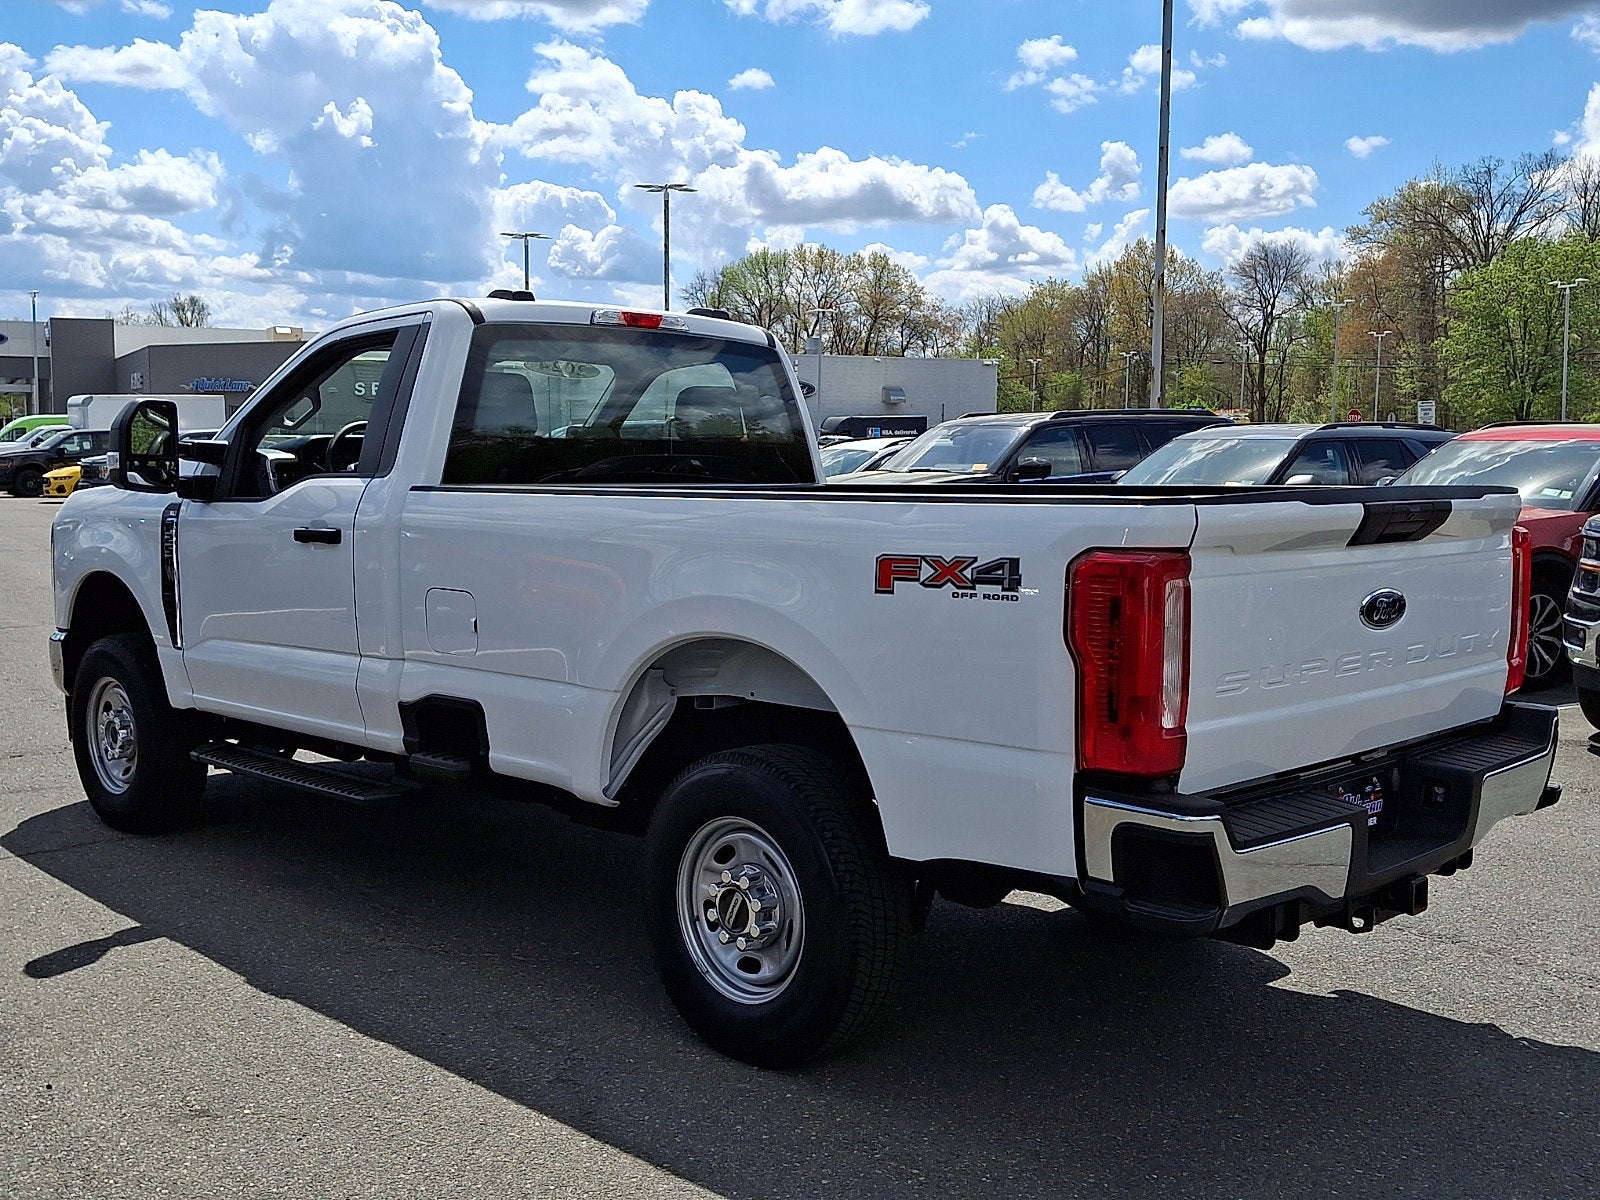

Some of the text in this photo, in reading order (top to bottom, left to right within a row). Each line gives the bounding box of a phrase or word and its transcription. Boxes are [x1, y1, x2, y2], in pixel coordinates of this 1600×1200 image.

[197, 377, 250, 392] Quick Lane
[1348, 414, 1362, 422] STOP
[874, 553, 1022, 595] FX4
[951, 591, 1020, 602] OFF ROAD
[1372, 597, 1400, 621] Ford
[1215, 629, 1500, 698] SUPER DUTY
